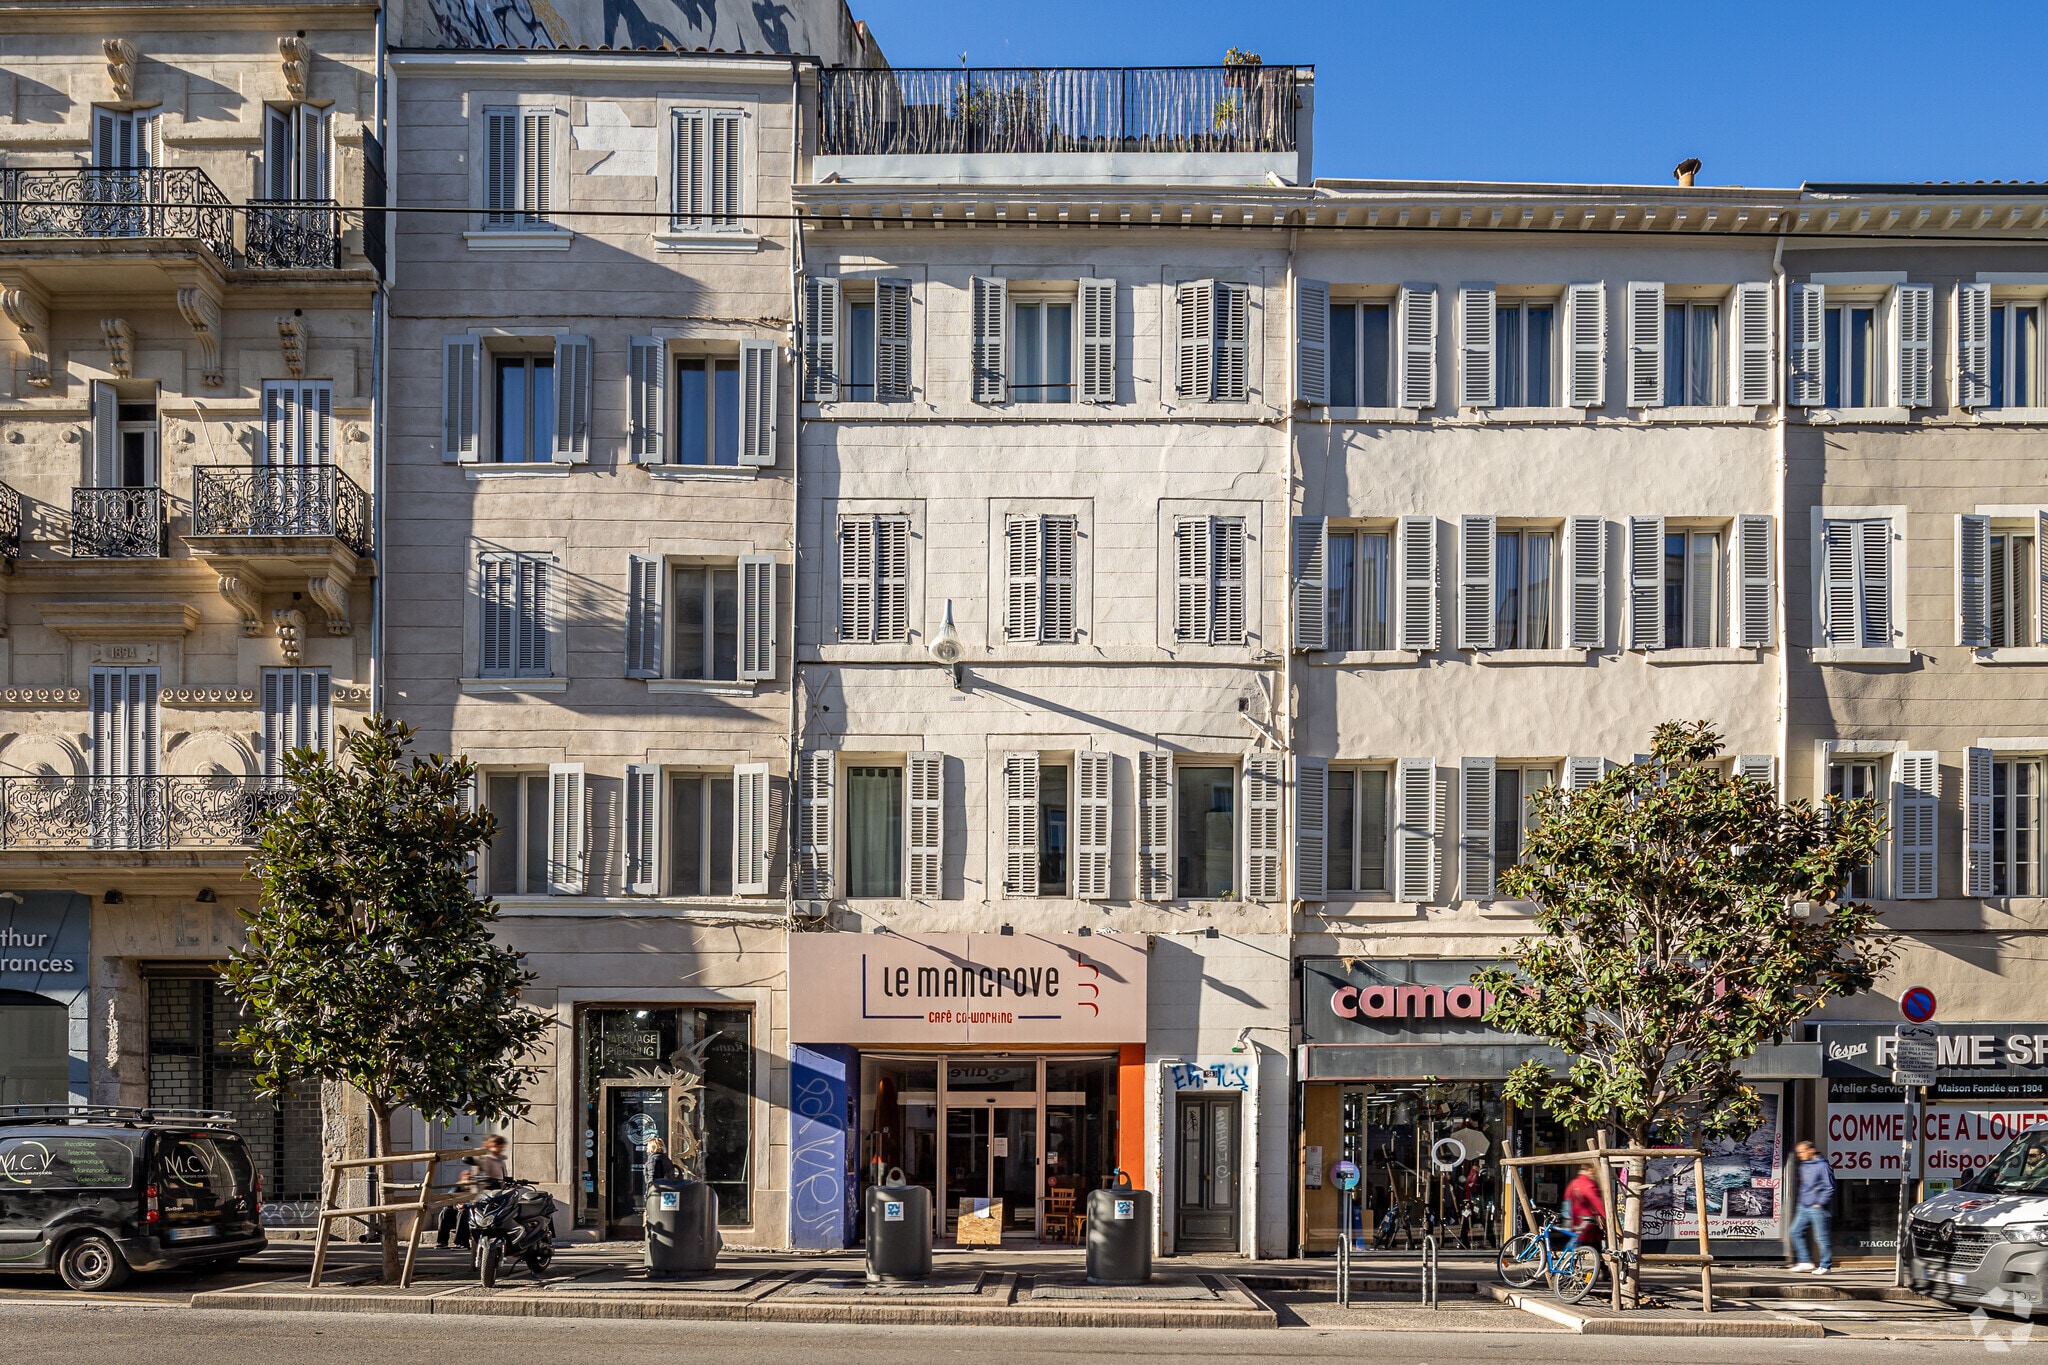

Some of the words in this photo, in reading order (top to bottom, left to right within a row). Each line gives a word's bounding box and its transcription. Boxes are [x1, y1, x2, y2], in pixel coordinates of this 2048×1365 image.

[111, 647, 136, 658] 1894
[0, 927, 47, 947] thur
[1, 958, 74, 972] rances
[605, 1034, 657, 1044] TATOUAGE
[1828, 1040, 1868, 1062] Vespa
[1876, 1035, 1996, 1066] RME
[1831, 1083, 1867, 1093] Atelier
[1937, 1083, 1970, 1093] Maison
[1972, 1083, 2005, 1093] Fondée
[2007, 1085, 2019, 1093] en
[2022, 1084, 2043, 1093] 1904
[1955, 1113, 1970, 1140] A
[1830, 1151, 1872, 1169] 236
[1721, 1218, 1756, 1226] sourires
